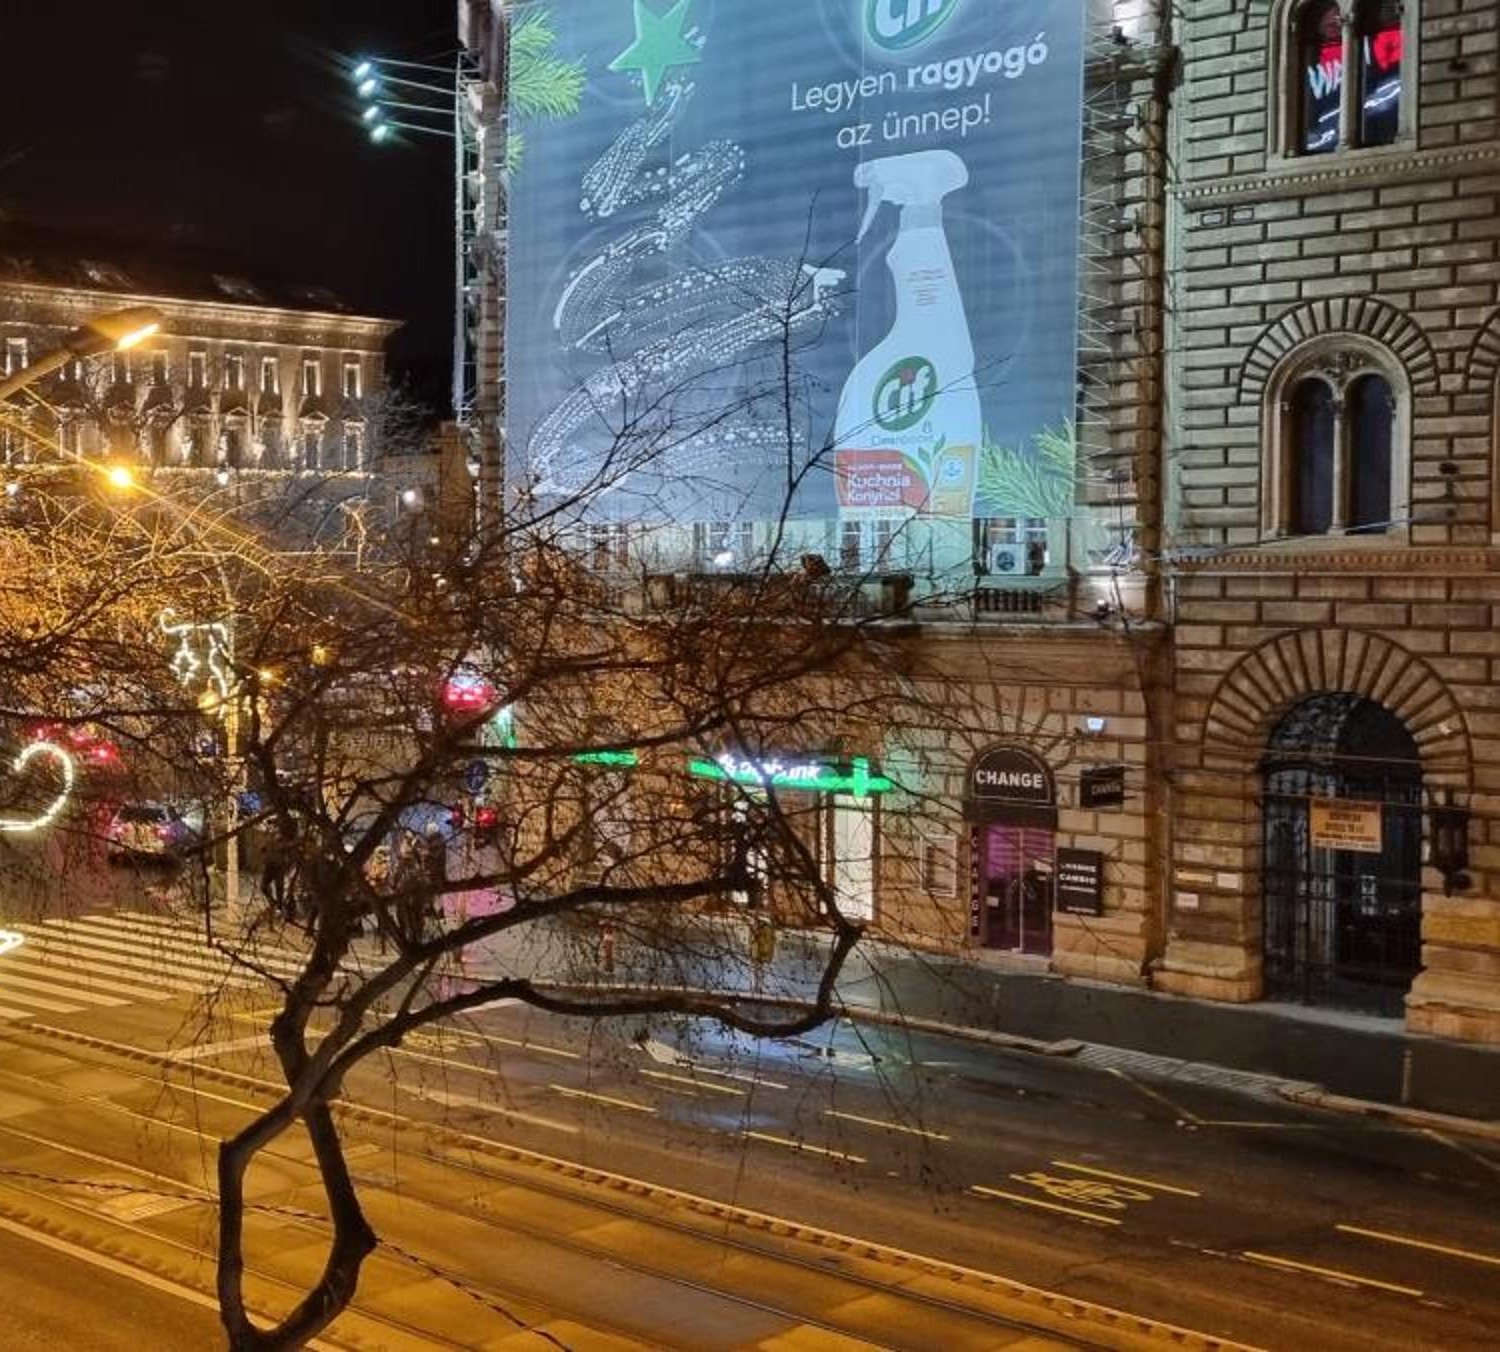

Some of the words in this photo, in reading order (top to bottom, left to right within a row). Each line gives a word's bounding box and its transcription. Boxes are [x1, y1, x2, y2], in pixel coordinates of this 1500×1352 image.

[791, 70, 896, 113] Legyen
[907, 32, 1049, 90] ragyogó
[837, 123, 872, 149] az
[883, 92, 991, 137] ünnep!
[975, 770, 1043, 789] CHANGE
